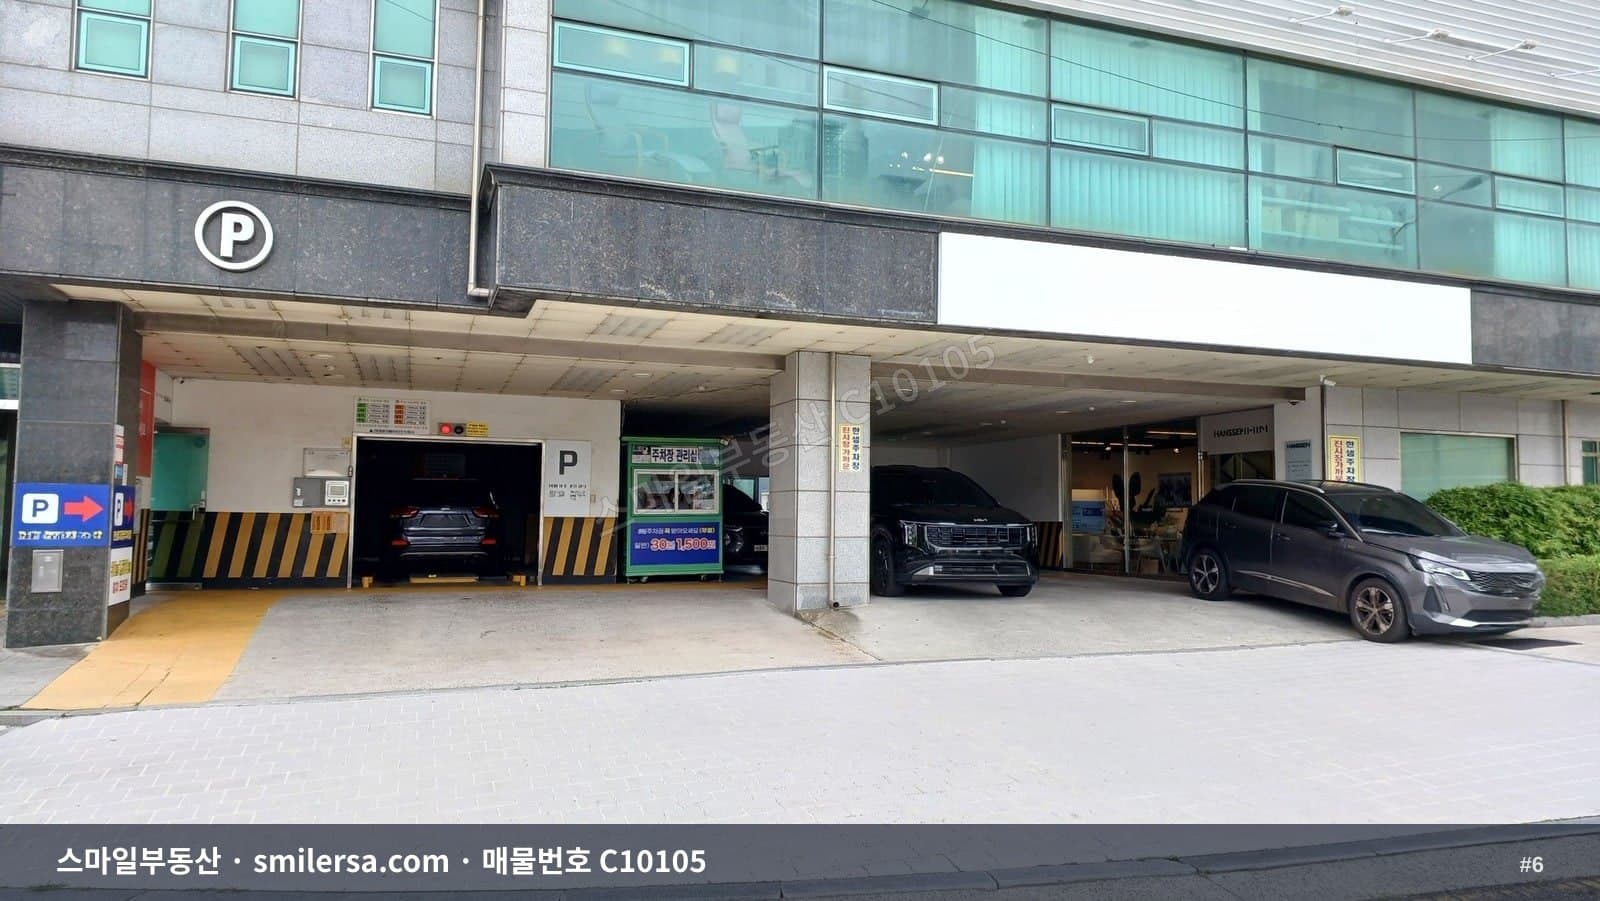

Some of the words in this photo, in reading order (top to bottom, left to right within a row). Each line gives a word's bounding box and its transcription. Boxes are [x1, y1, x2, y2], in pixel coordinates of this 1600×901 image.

[220, 212, 255, 258] P
[559, 450, 578, 475] P
[652, 448, 674, 463] 주차장
[676, 448, 698, 463] 관리실
[32, 499, 49, 518] P
